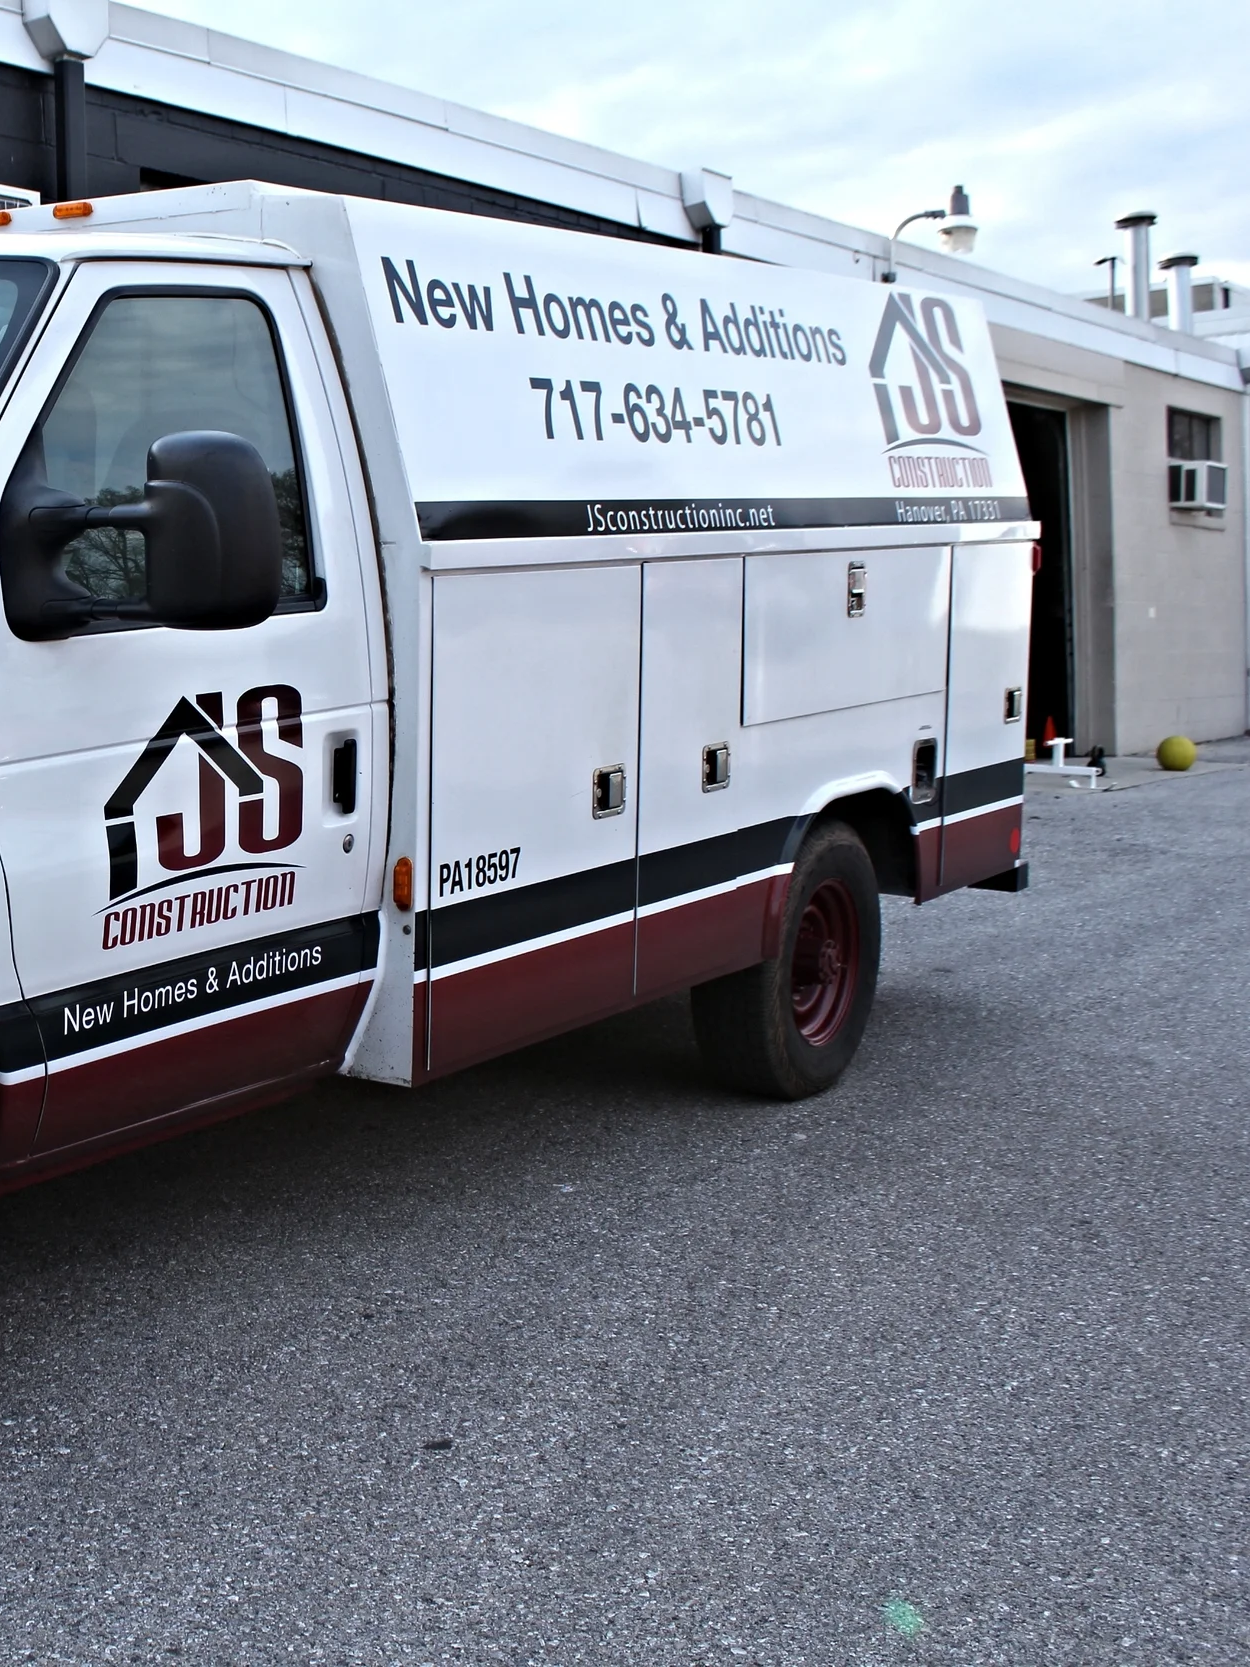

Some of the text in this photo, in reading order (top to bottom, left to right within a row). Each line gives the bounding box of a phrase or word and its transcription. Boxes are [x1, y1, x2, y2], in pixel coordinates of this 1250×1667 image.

[381, 256, 847, 366] New Homes & Additions
[529, 378, 783, 447] 717-634-5781
[888, 455, 993, 488] CONSTRUCTION
[587, 503, 776, 532] JSconstructioninc.net
[895, 501, 1001, 523] Hanover, PA 17331
[156, 684, 303, 871] JS
[439, 846, 521, 897] PA18597
[102, 871, 295, 950] CONSTRUCTION
[63, 945, 323, 1035] New Homes & Additions
